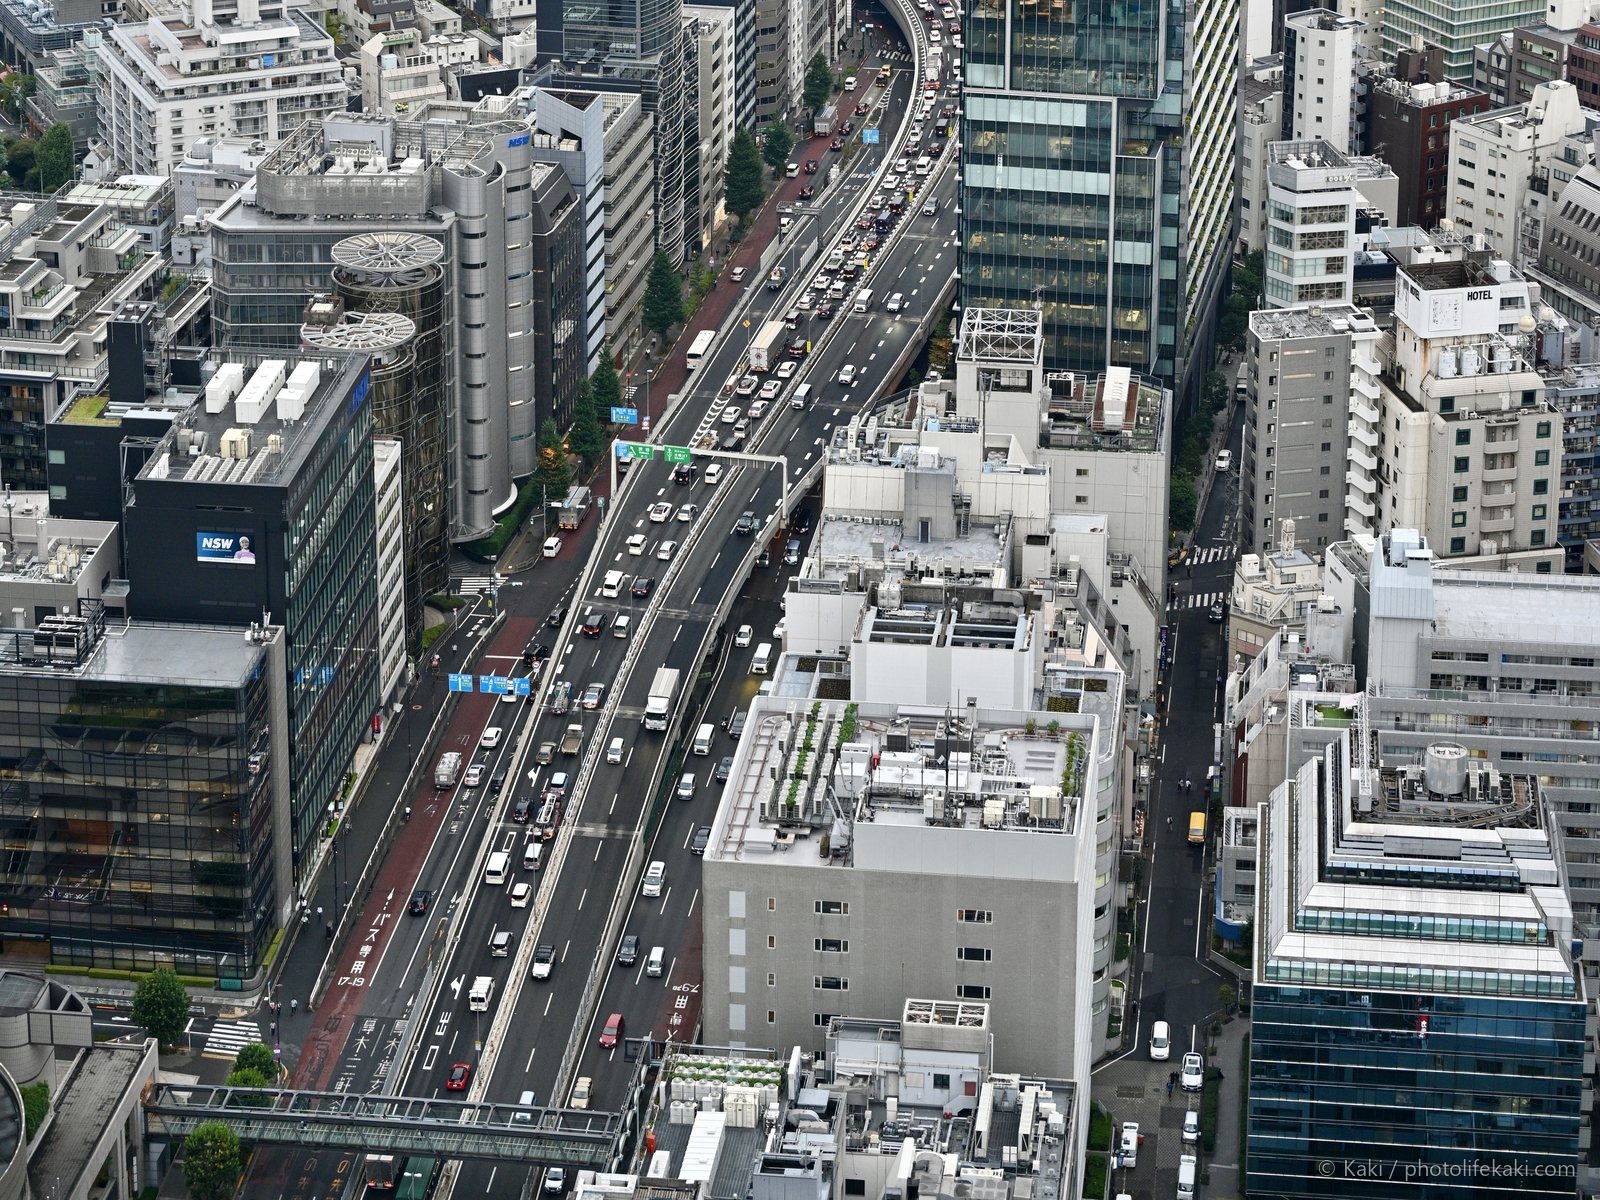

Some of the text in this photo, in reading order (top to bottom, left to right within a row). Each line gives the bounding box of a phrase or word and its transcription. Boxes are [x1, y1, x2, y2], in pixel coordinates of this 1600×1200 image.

[1467, 290, 1493, 301] HOTEL
[202, 537, 233, 549] NSW
[350, 913, 391, 974] バス専用
[337, 977, 365, 987] 17-19
[423, 1011, 452, 1071] 出口
